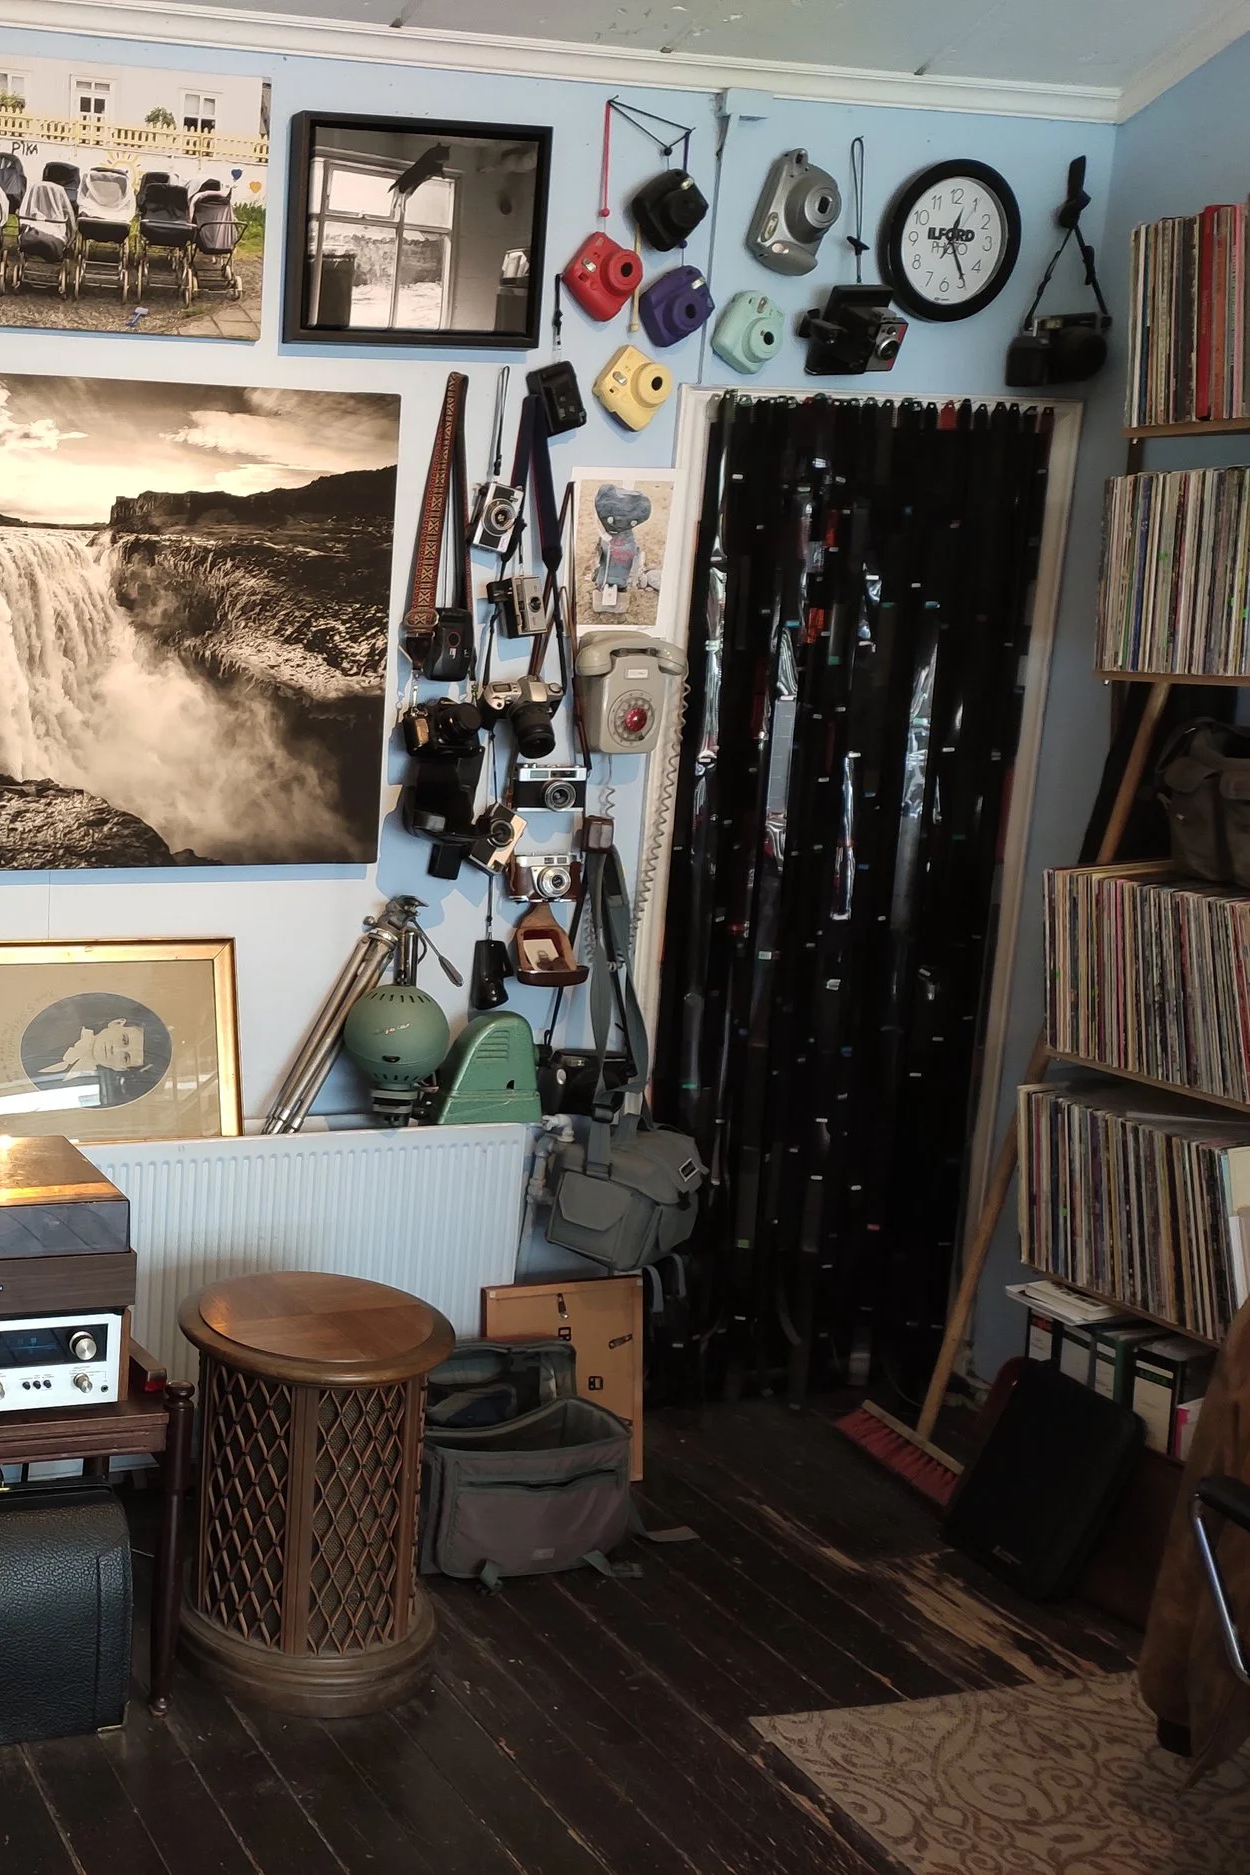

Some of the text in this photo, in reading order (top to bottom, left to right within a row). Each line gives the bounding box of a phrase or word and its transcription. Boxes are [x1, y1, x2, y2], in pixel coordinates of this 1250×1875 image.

[11, 140, 38, 156] PIKA
[931, 195, 943, 211] 11
[950, 188, 965, 205] 12
[972, 197, 978, 212] 1
[914, 209, 930, 226] 10
[980, 213, 991, 230] 2
[908, 230, 919, 247] 9
[927, 227, 975, 242] ILFORD
[982, 235, 993, 252] 3
[911, 253, 922, 270] 8
[971, 259, 982, 274] 4
[925, 270, 934, 287] 7
[939, 276, 950, 293] 6
